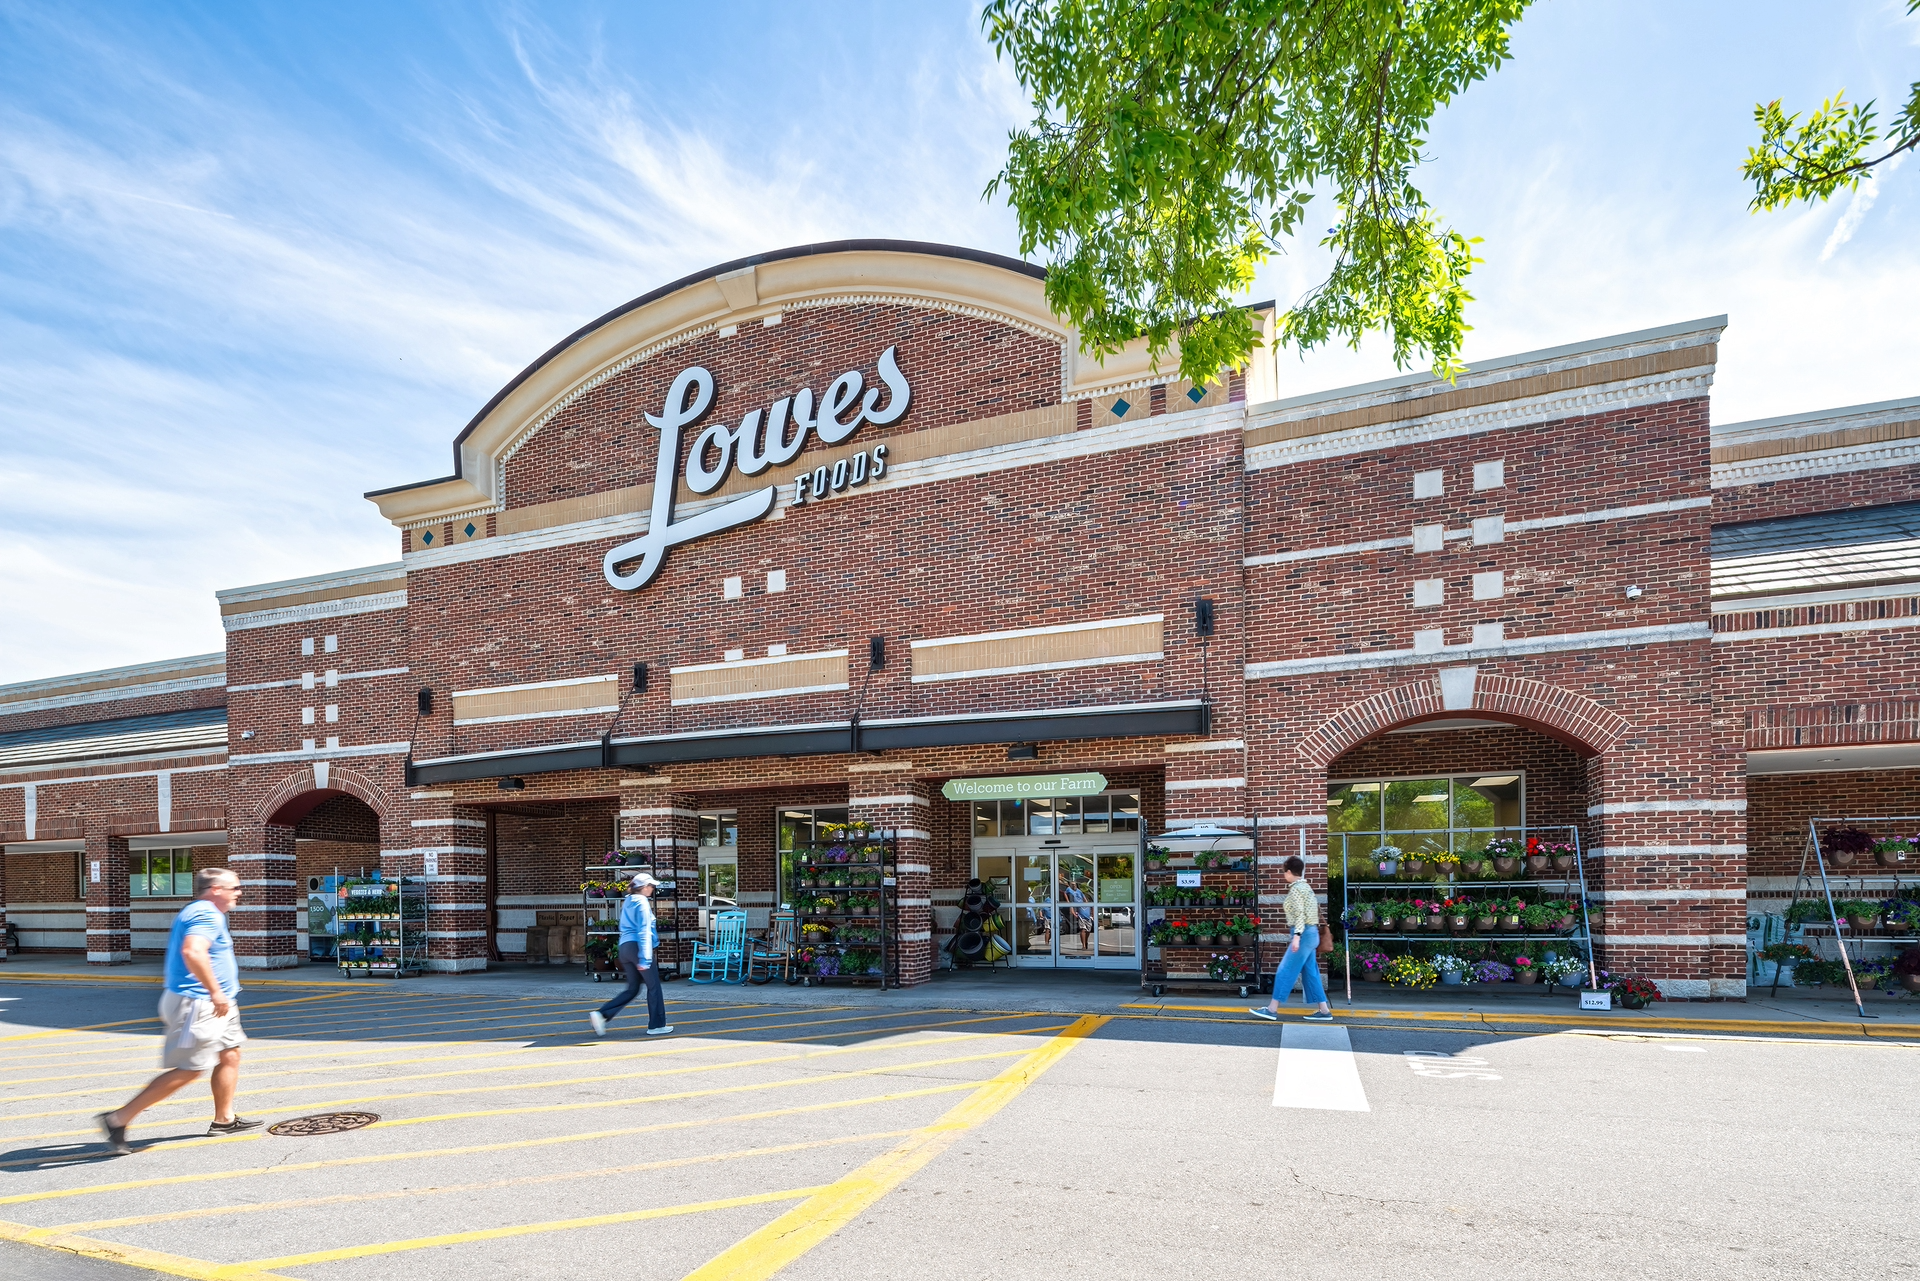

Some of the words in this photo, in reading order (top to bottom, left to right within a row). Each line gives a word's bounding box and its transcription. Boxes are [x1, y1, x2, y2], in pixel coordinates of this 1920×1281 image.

[603, 345, 912, 591] Lowes
[792, 444, 889, 506] FOODS
[953, 782, 1014, 794] Welcome
[1017, 782, 1031, 792] to
[1034, 781, 1057, 791] our
[1060, 777, 1096, 790] Farm
